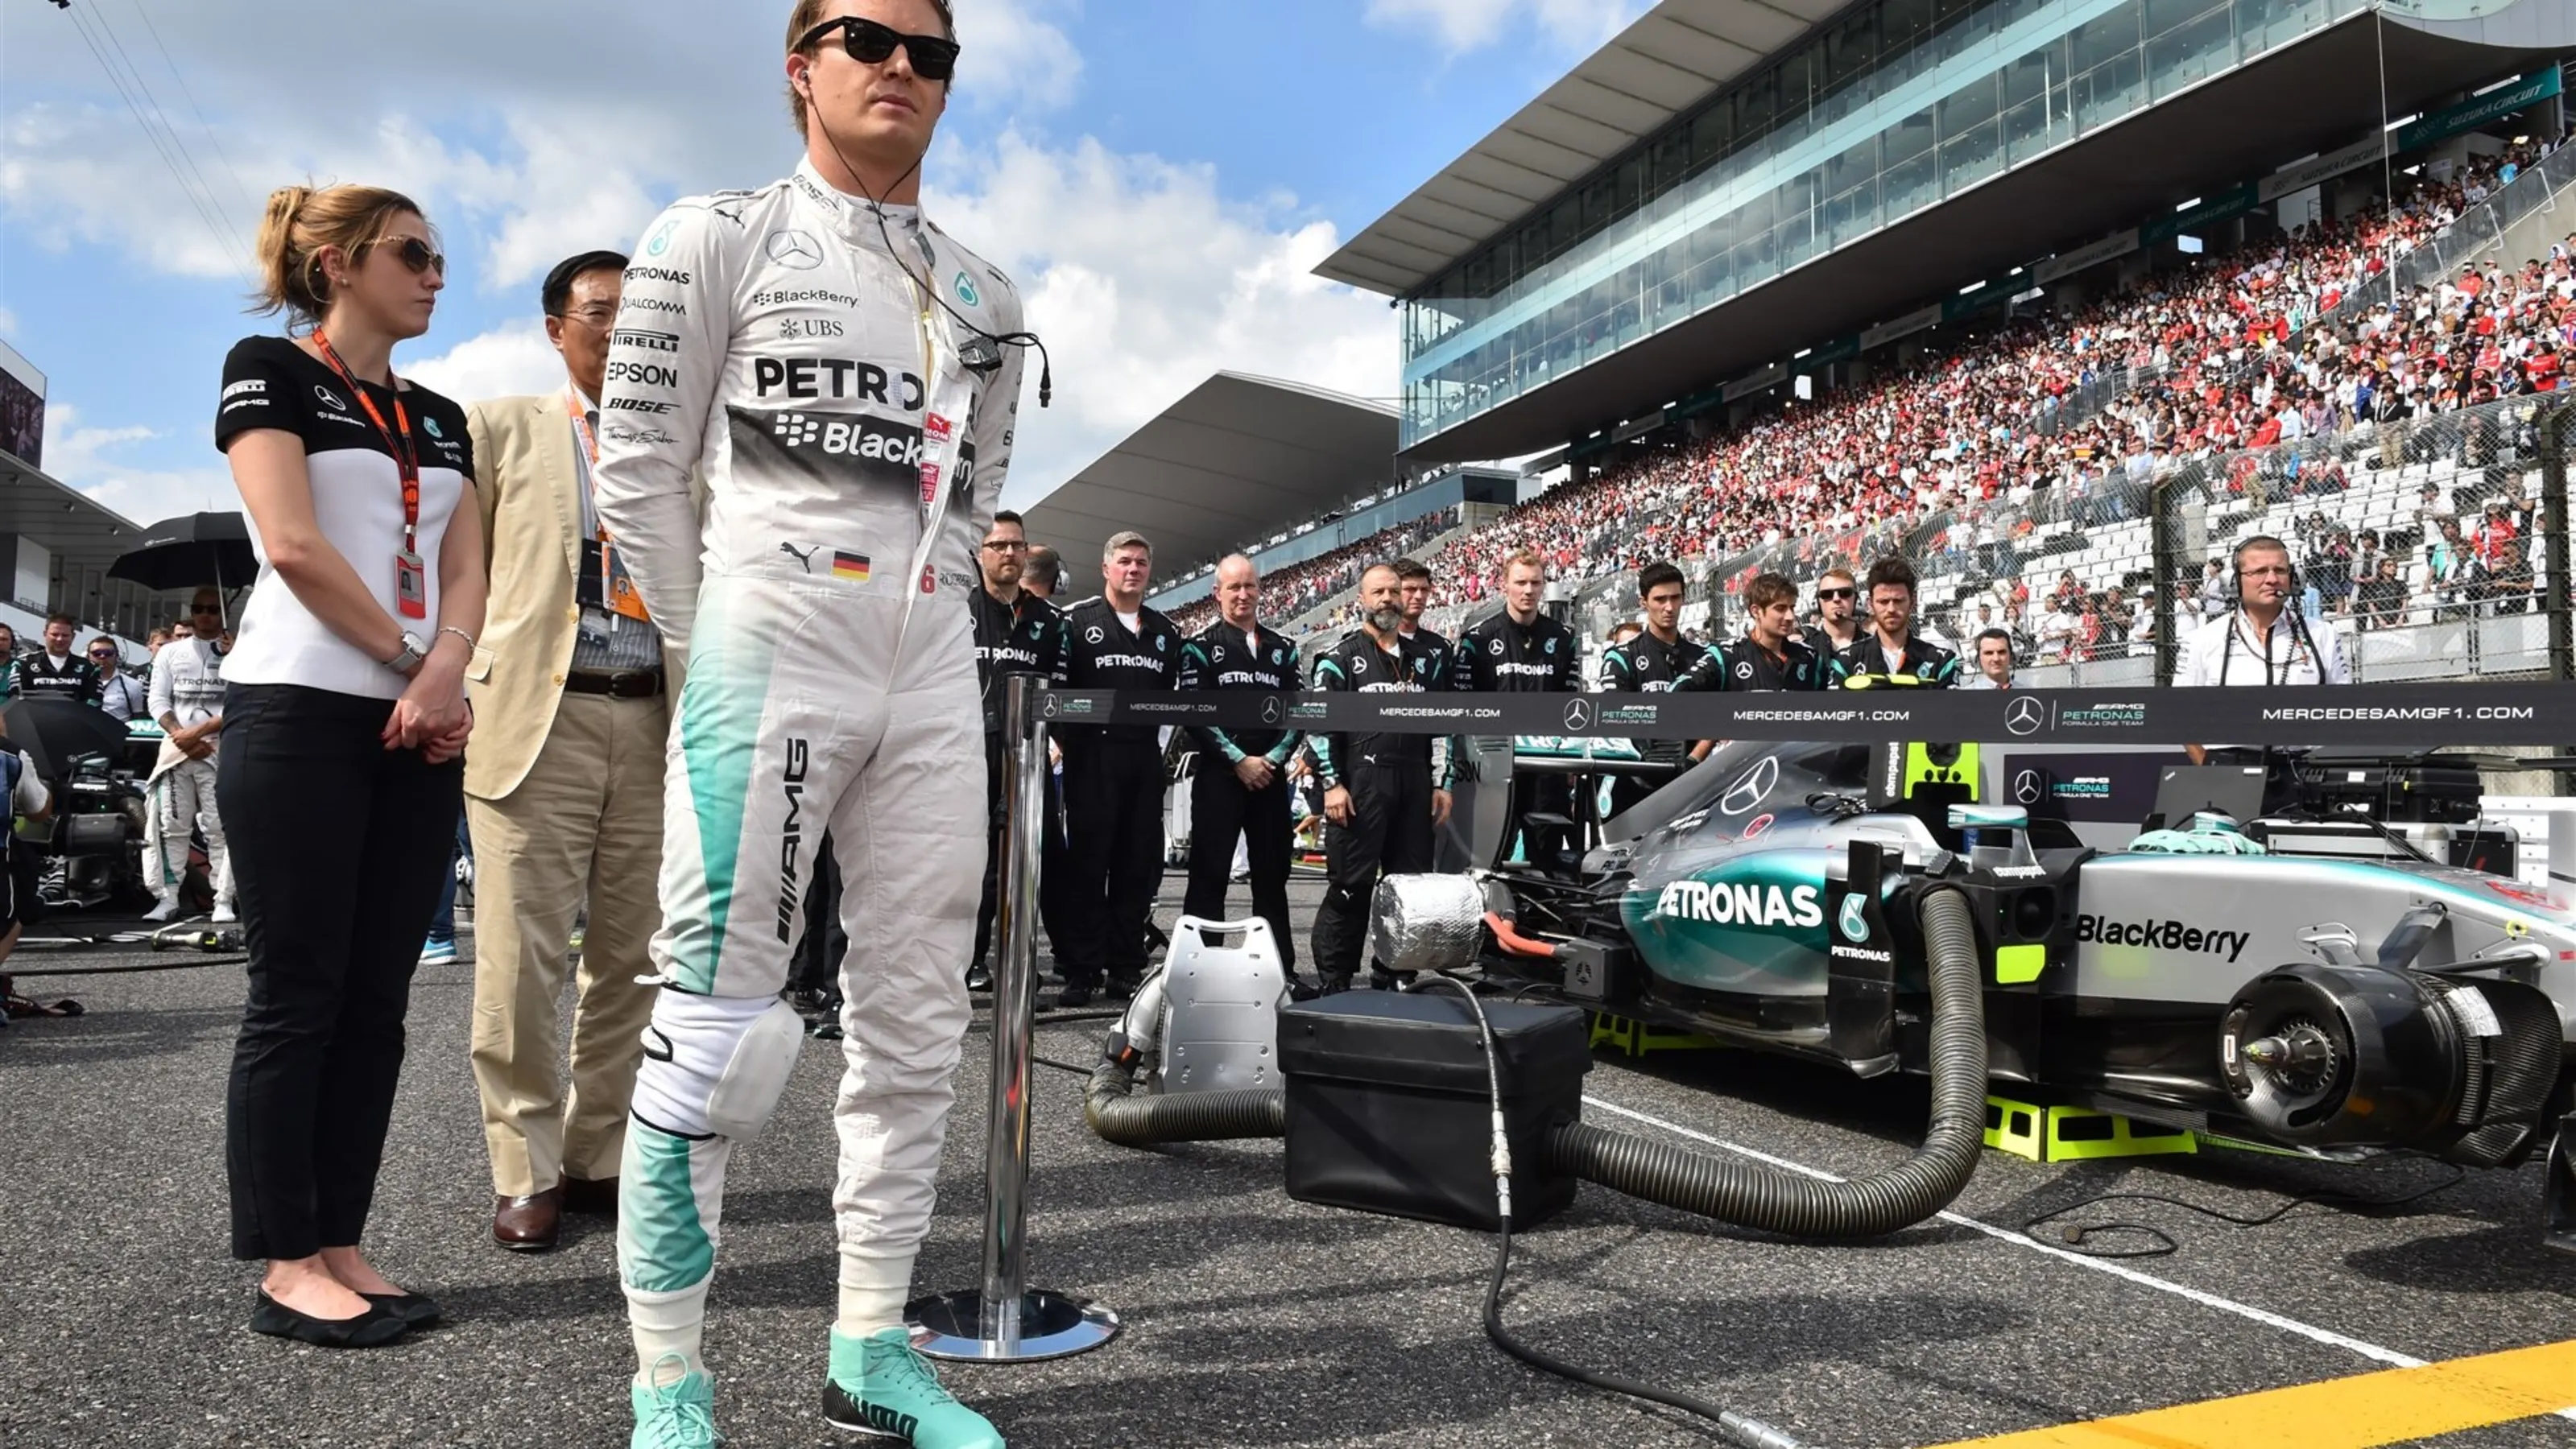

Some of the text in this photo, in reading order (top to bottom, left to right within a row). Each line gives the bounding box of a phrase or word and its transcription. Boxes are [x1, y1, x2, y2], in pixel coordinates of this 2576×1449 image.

[2446, 85, 2544, 129] SUZUKA CIRCUIT
[624, 267, 689, 284] PETRONAS
[774, 290, 858, 308] BlackBerry
[804, 319, 844, 336] UBS
[608, 362, 677, 388] EPSON
[755, 358, 924, 411] PETRO
[604, 398, 681, 415] BOSE
[920, 564, 935, 593] 6
[975, 646, 1037, 666] ETRONAS
[1095, 654, 1164, 674] PETRONAS
[1495, 662, 1554, 676] PETRONAS
[1380, 708, 1500, 717] MERCEDESAMGF1.COM
[1602, 711, 1656, 719] PETRONAS
[1734, 710, 1910, 720] MERCEDESAMGF1.COM
[2063, 711, 2144, 720] PETRONAS
[2263, 706, 2533, 720] MERCEDESAMGF1.COM
[2053, 784, 2109, 792] PETRONAS
[785, 738, 808, 898] AMG
[1656, 880, 1823, 927] PETRONAS
[2075, 914, 2251, 964] BlackBerry
[1830, 945, 1891, 963] PETRONAS
